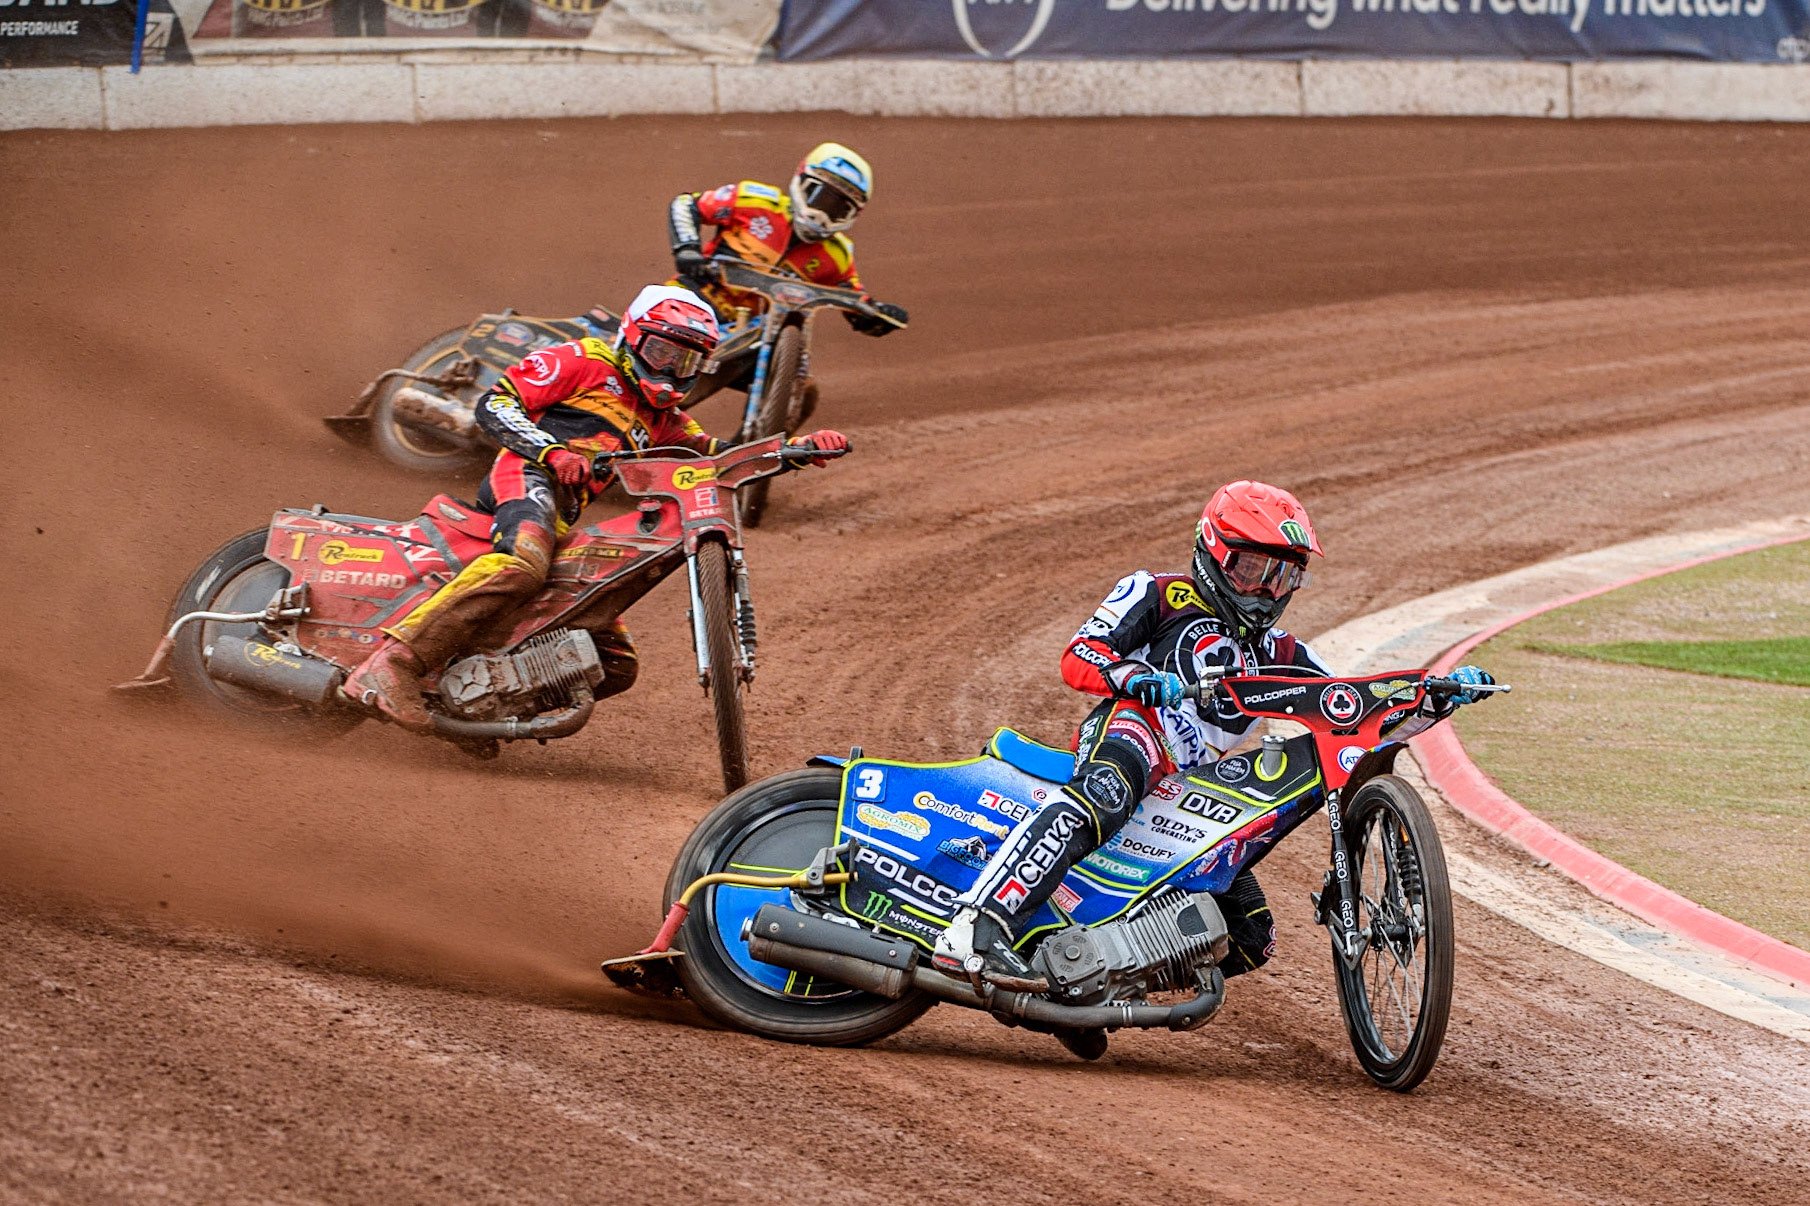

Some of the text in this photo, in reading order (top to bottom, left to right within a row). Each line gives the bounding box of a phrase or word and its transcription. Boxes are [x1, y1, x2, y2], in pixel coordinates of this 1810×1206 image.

[1, 20, 79, 36] PERFORMANCE
[805, 258, 820, 271] 2
[470, 323, 496, 338] 2
[689, 508, 724, 518] BETA
[290, 532, 306, 561] 1
[319, 569, 407, 589] BETARD
[1188, 623, 1219, 640] BELLE
[1244, 685, 1307, 705] POLCOPPER
[856, 768, 885, 799] 3
[1152, 789, 1175, 800] INS
[1158, 780, 1182, 796] BS
[914, 791, 1010, 839] ComfortRent
[1182, 793, 1237, 824] DVR
[1329, 802, 1342, 831] GEO
[864, 807, 921, 835] AGROMIX
[1151, 815, 1208, 839] OLDY'S
[1151, 826, 1198, 844] CONCRETING
[938, 840, 987, 868] BIGFOOT
[1121, 838, 1176, 859] DOCUFY
[1087, 853, 1150, 880] MOTOREX
[1335, 852, 1348, 879] GEO
[854, 847, 962, 914] POLCO
[1341, 900, 1354, 928] GEO
